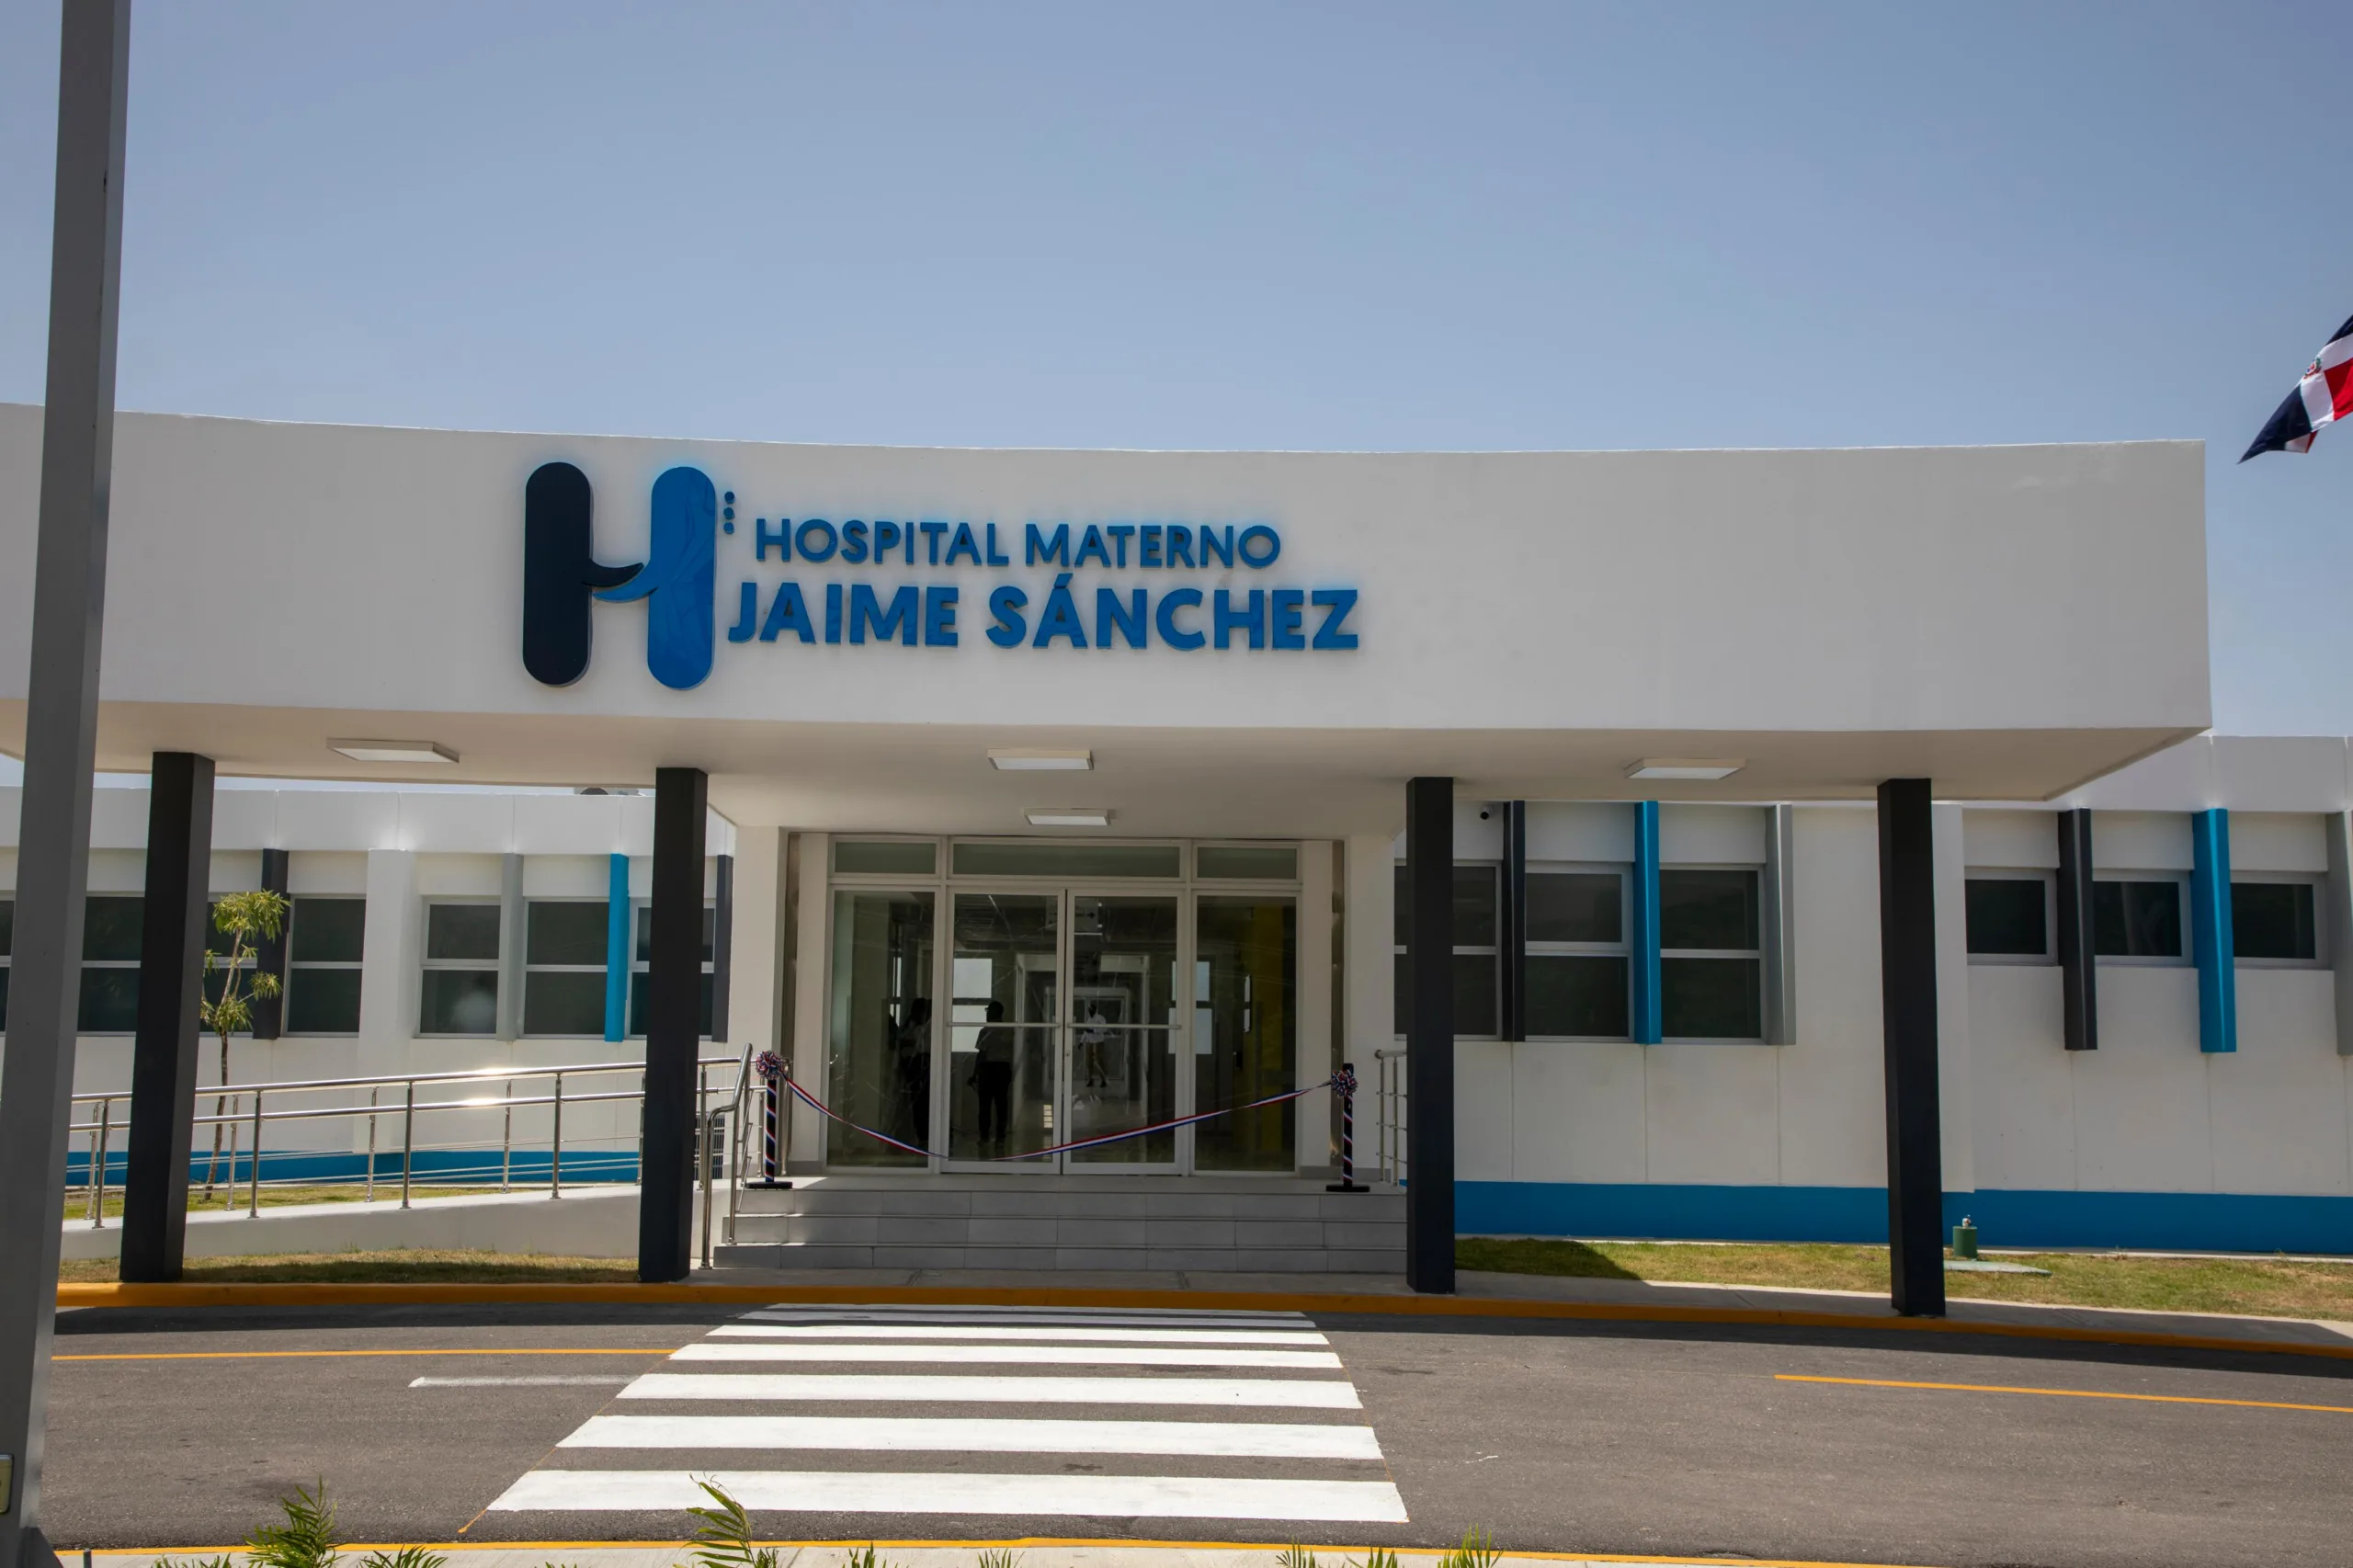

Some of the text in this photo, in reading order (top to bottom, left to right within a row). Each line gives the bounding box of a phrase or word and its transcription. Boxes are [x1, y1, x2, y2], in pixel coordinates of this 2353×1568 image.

[756, 517, 1281, 567] HOSPITAL MATERNO
[728, 573, 1358, 650] JAIME SÁNCHEZ
